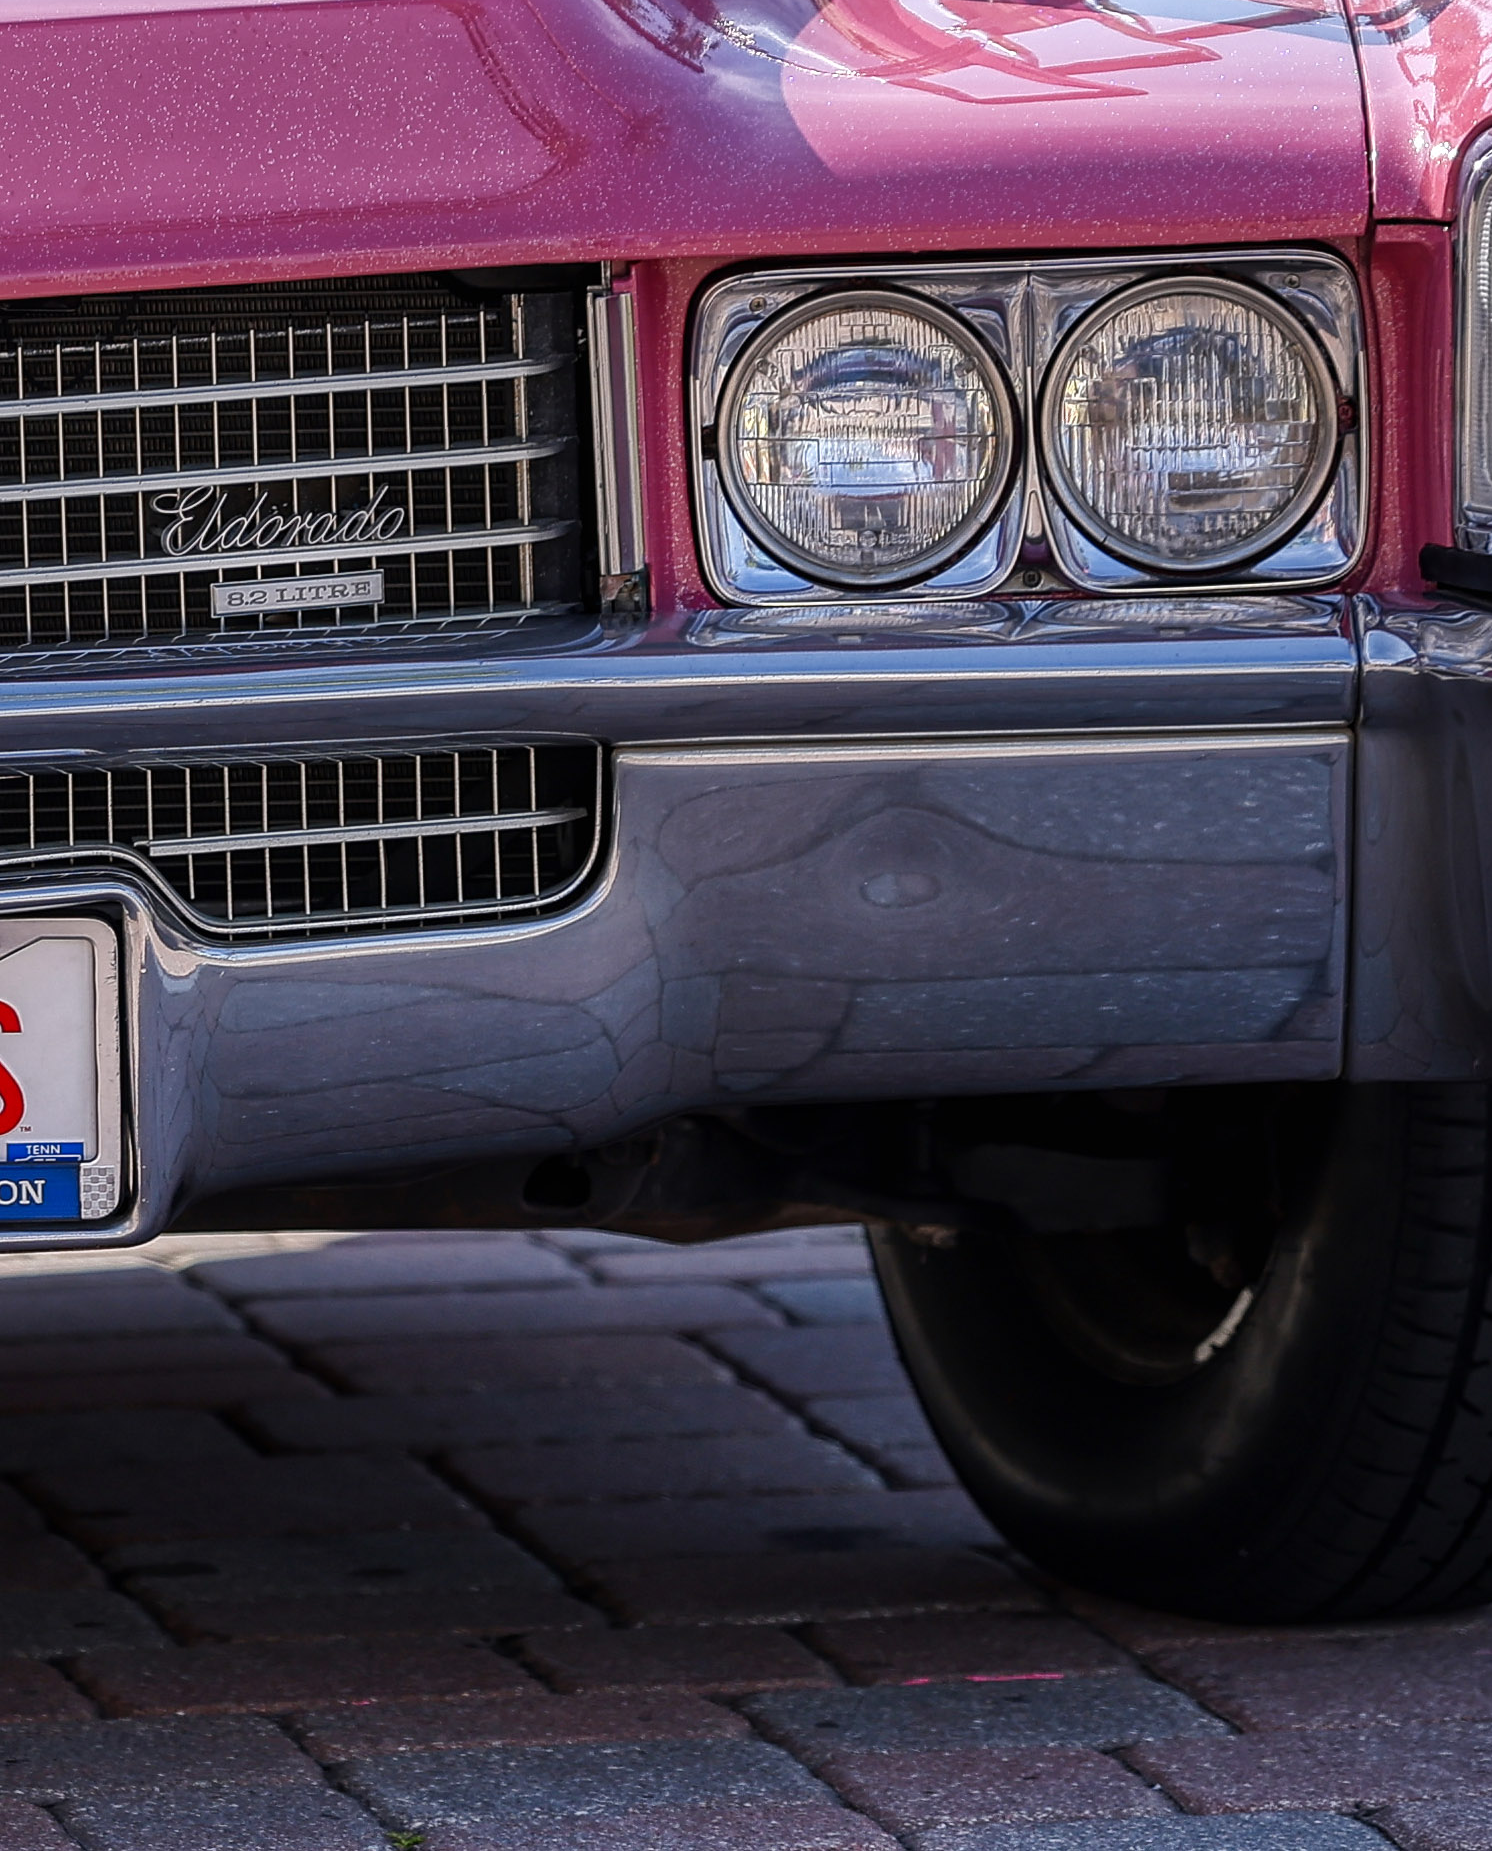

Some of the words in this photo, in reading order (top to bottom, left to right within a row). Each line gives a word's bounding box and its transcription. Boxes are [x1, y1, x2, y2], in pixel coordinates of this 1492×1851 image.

[150, 482, 406, 556] Eldorado
[226, 589, 268, 607] 8.2
[275, 581, 371, 604] LITRE
[26, 1144, 61, 1155] TENN
